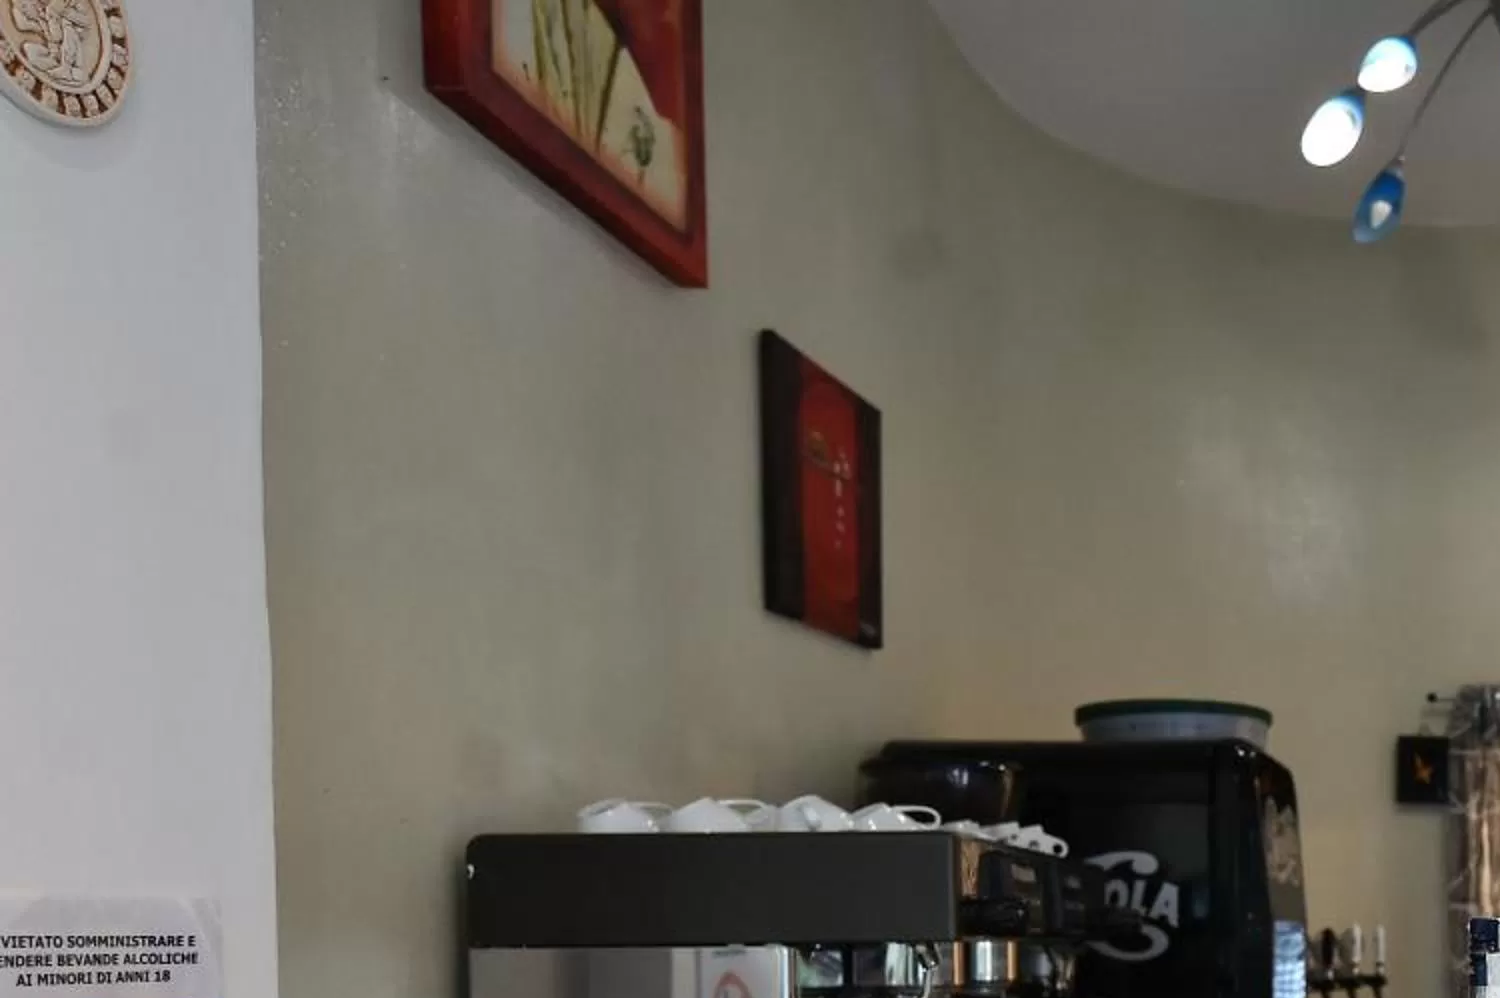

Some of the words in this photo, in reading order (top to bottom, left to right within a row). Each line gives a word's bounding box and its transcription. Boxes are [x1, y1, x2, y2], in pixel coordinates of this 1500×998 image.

[1, 935, 63, 949] VIETATO
[67, 935, 184, 948] SOMMINISTRARE
[188, 935, 196, 947] E
[58, 953, 119, 967] BEVANDE
[123, 953, 199, 965] ALCOLICHE
[16, 974, 32, 987] AI
[37, 972, 92, 986] MINORI
[97, 971, 112, 984] DI
[116, 971, 150, 984] ANNI
[154, 970, 171, 983] 18
